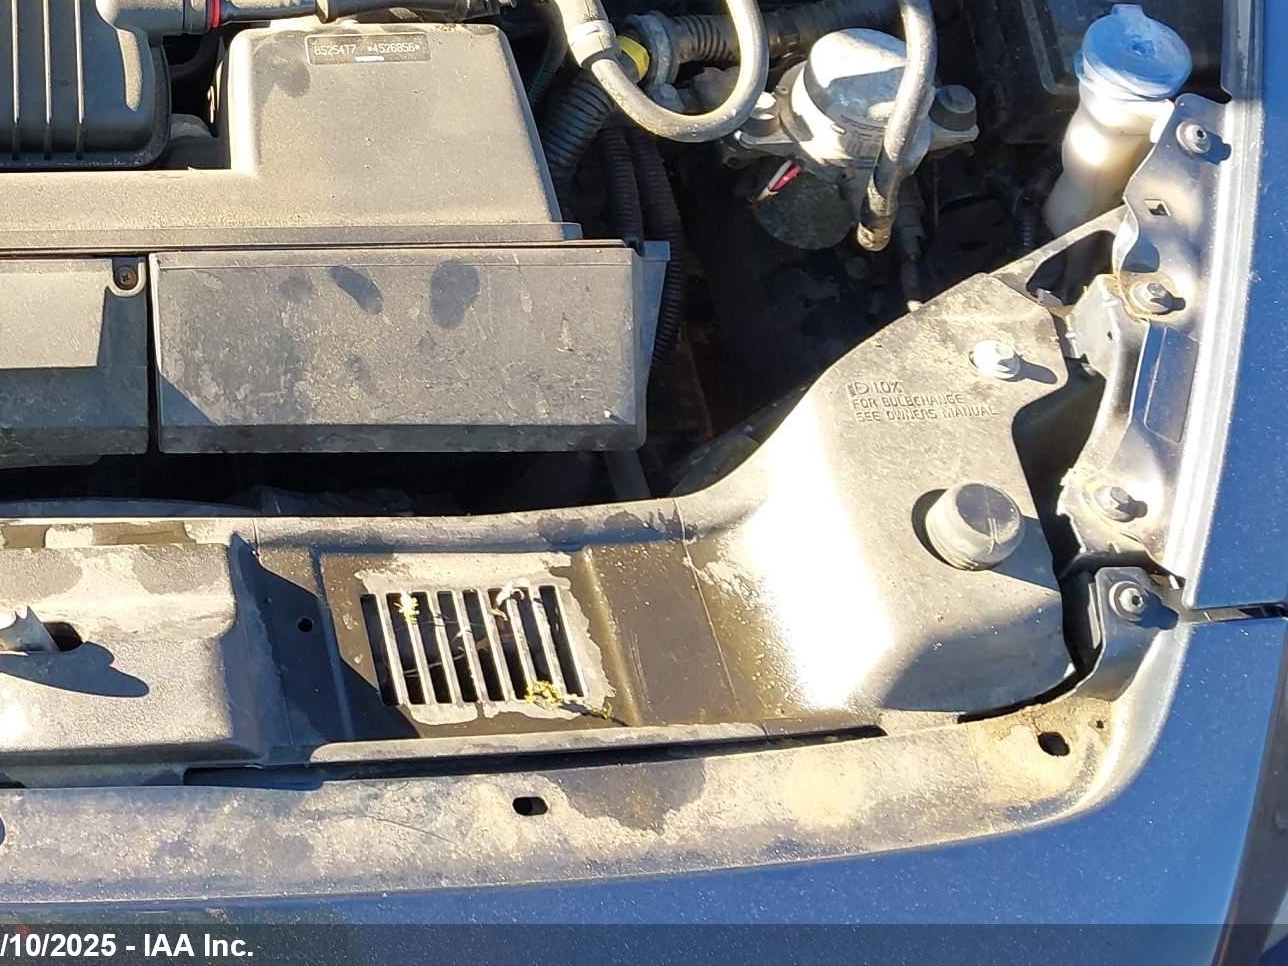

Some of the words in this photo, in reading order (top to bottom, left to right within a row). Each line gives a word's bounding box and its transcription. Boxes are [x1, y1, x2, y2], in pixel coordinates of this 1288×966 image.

[852, 396, 878, 409] FOR
[881, 393, 965, 408] BULBCHANGE
[856, 410, 881, 423] SEE
[886, 408, 938, 421] OWNERS
[942, 405, 1000, 419] MANUAL
